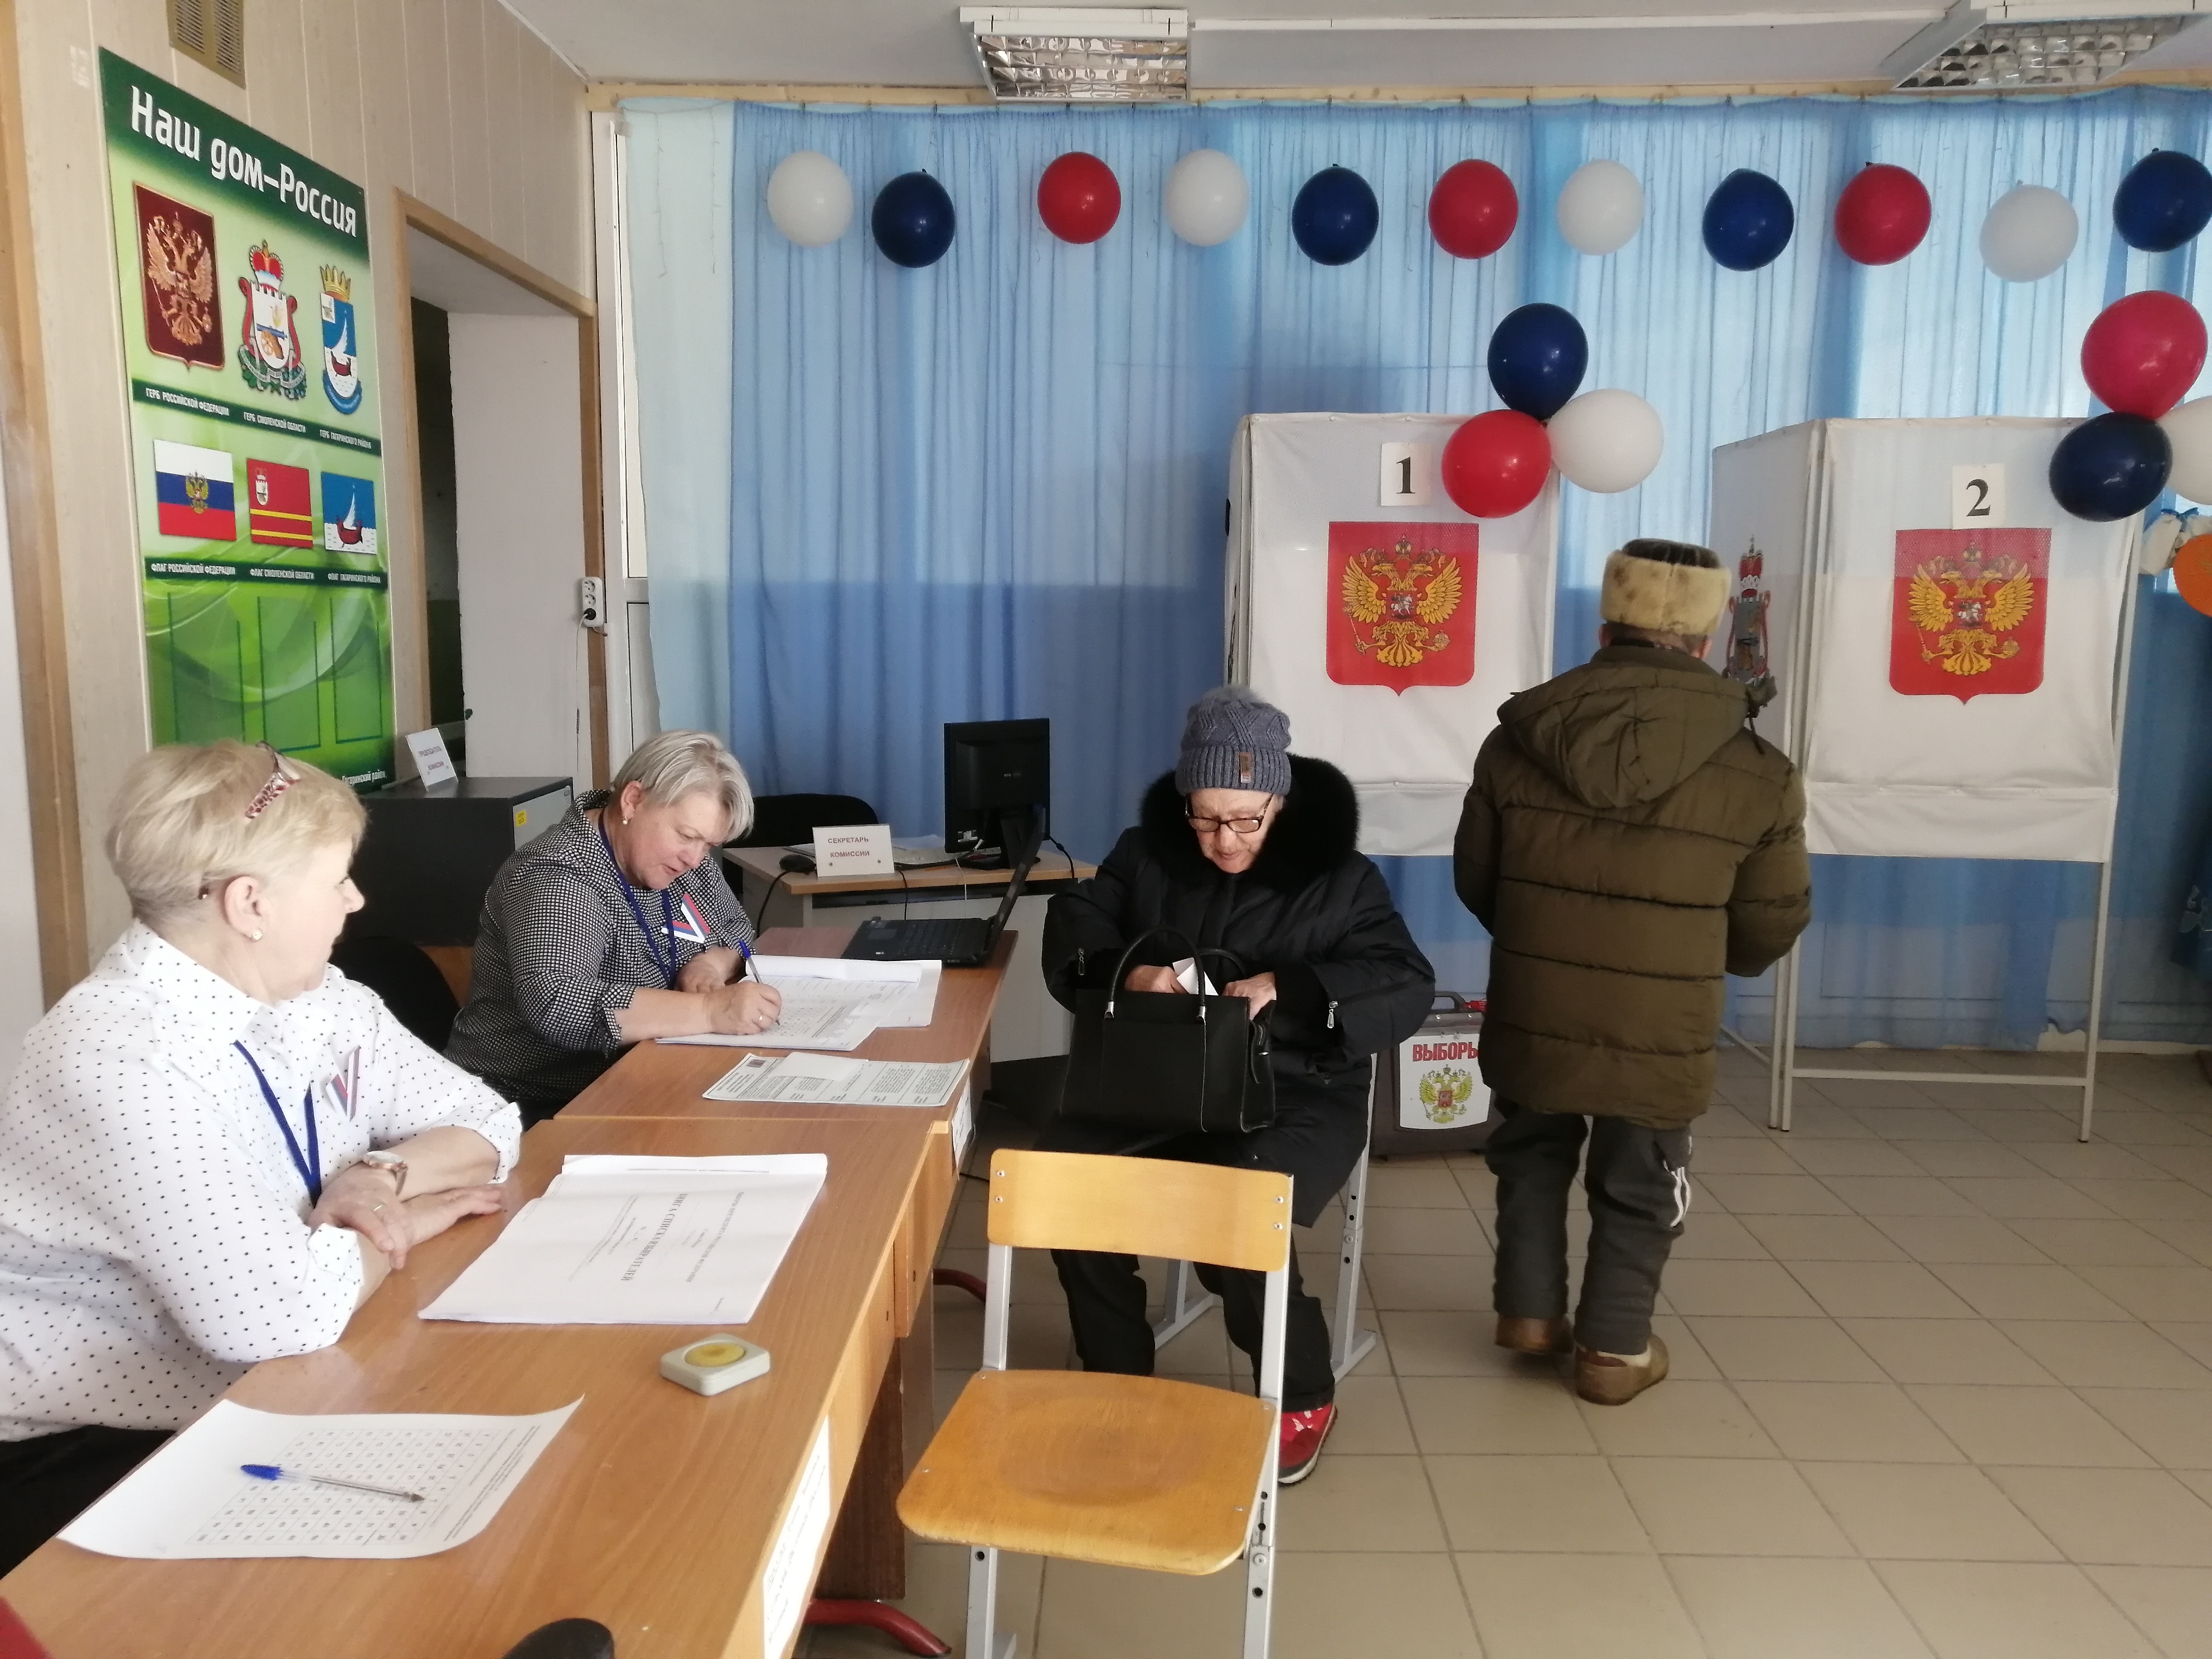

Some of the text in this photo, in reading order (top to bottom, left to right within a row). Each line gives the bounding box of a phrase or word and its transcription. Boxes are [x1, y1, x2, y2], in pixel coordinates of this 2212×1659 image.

[130, 85, 200, 162] Наш
[145, 387, 161, 400] ГЕРБ
[162, 391, 198, 409] РОССИЙСКОЙ
[244, 411, 255, 423] ГЕРБ
[319, 429, 330, 439] ГЕРБ
[1396, 456, 1416, 494] 1
[1966, 478, 1992, 517] 2
[151, 562, 236, 575] ФЛАГ РОССИЙСКОЙ ФЕДЕРАЦИИ
[250, 567, 263, 578] ФЛАГ
